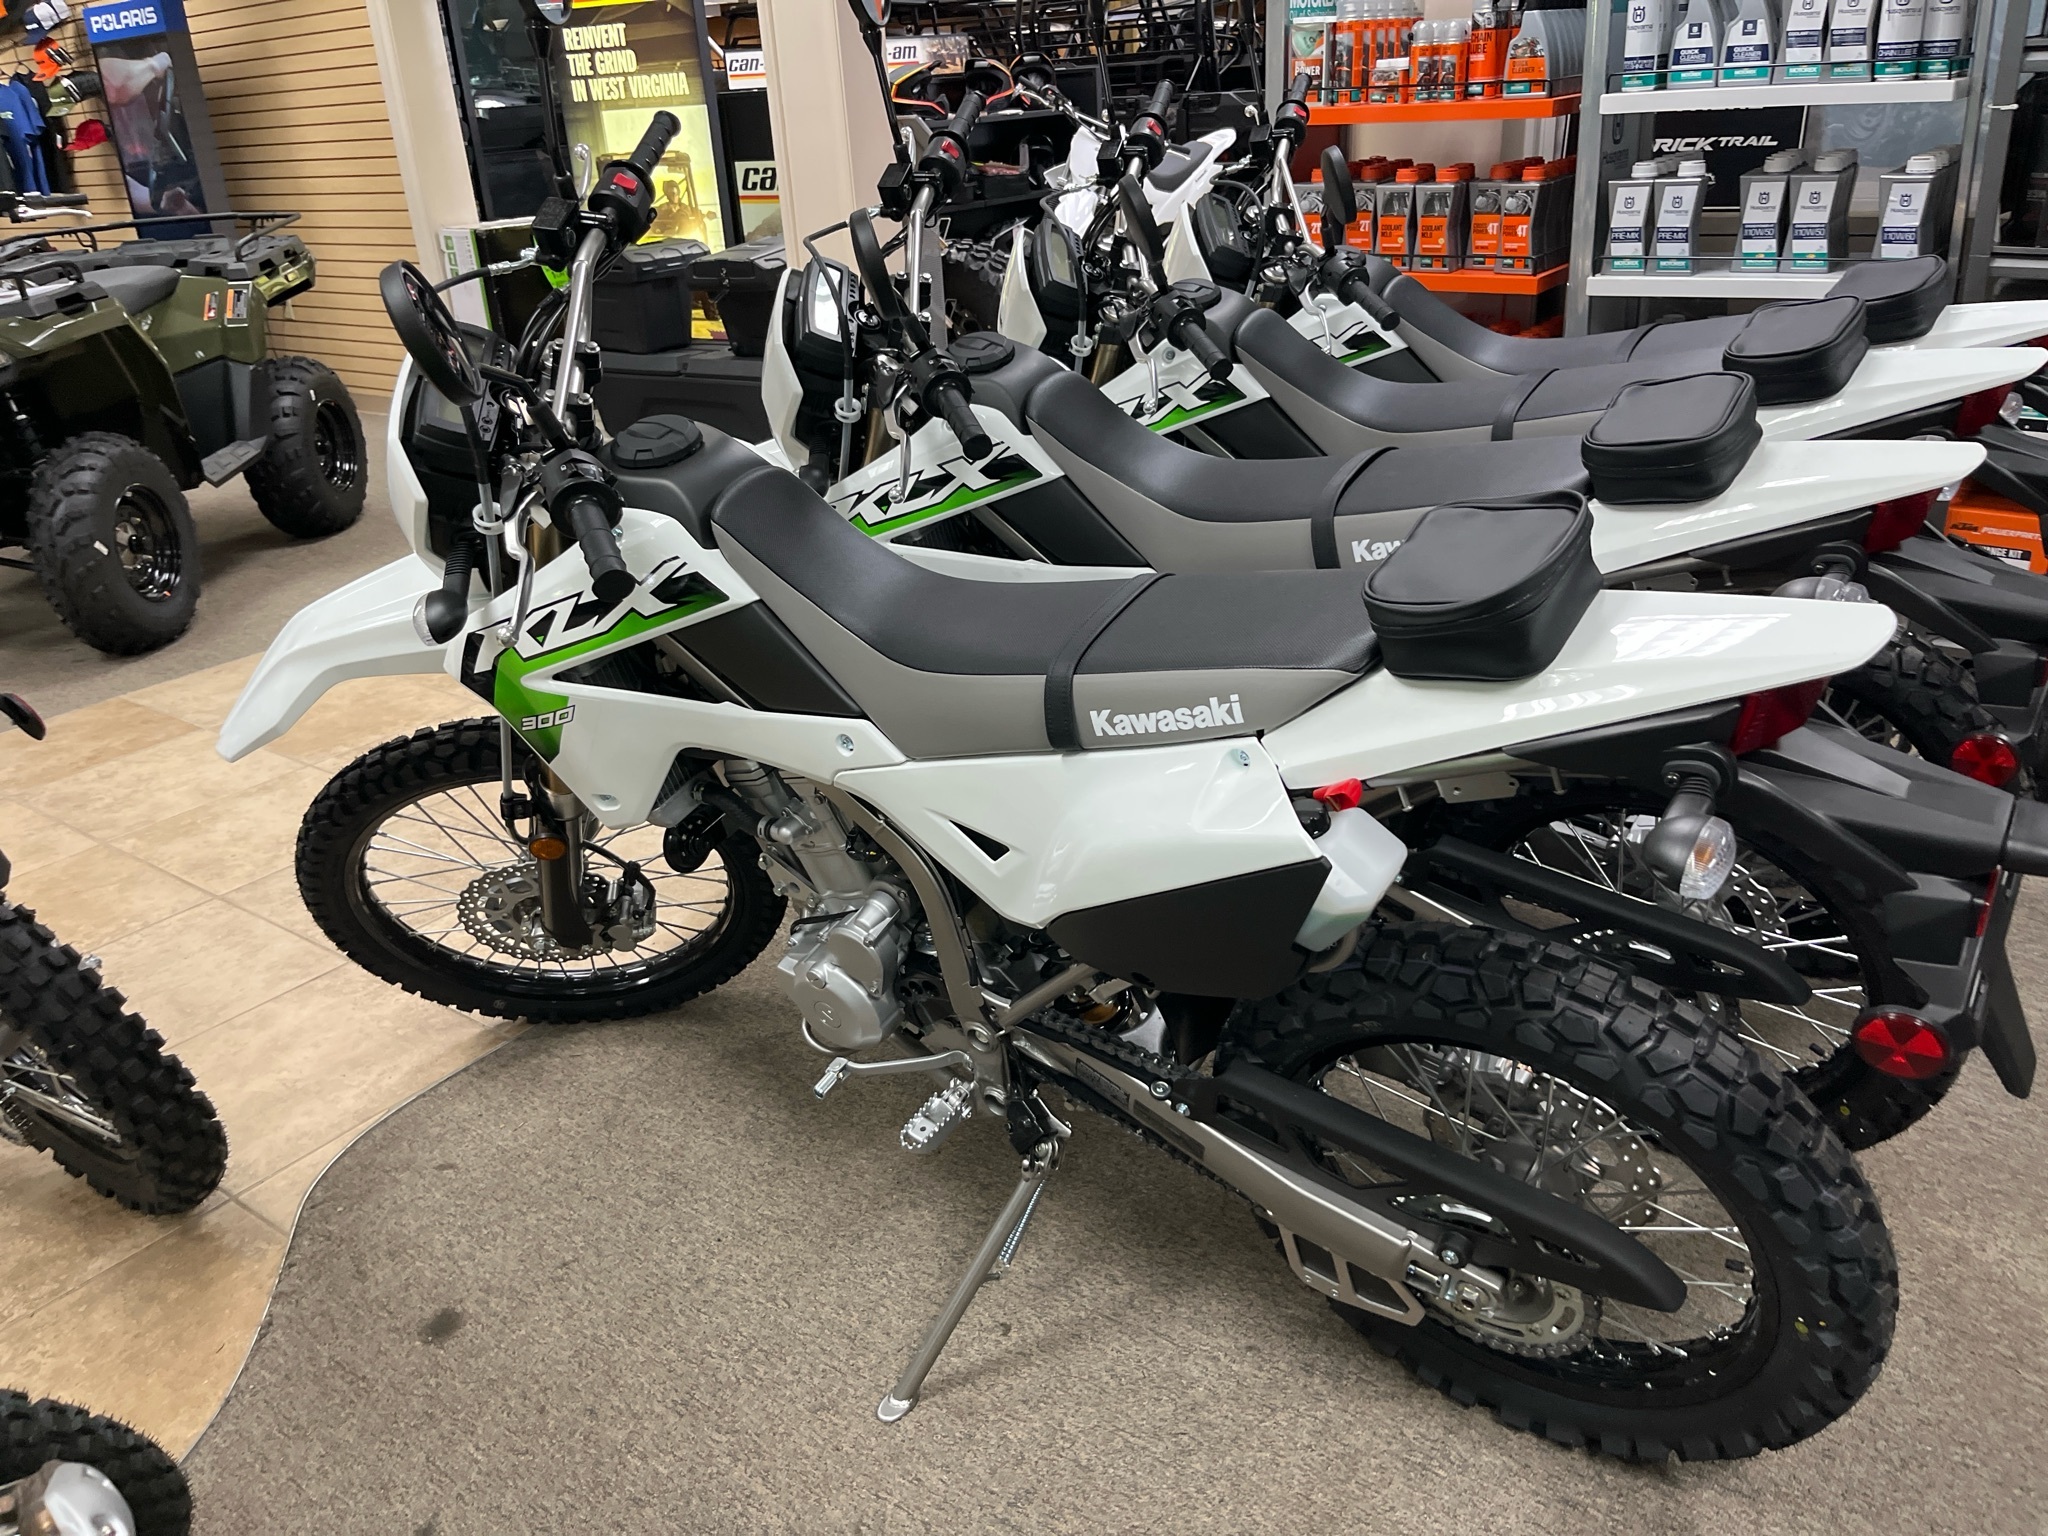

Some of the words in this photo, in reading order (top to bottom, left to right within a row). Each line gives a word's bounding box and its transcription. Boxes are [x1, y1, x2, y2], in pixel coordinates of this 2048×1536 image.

[90, 7, 158, 34] POLARIS
[562, 22, 627, 51] REINVENT
[1471, 32, 1493, 42] CHAIN
[1470, 43, 1487, 54] LUBE
[1733, 51, 1762, 59] CLEANER
[566, 52, 595, 77] THE
[594, 49, 638, 75] GRIND
[729, 57, 765, 72] can-
[1294, 65, 1321, 76] POWER
[570, 79, 589, 102] IN
[588, 76, 626, 101] WEST
[627, 71, 690, 99] VIRGINIA
[1653, 137, 1717, 152] RICK
[1717, 135, 1779, 147] TRAIL
[741, 167, 778, 191] ca
[1487, 223, 1499, 235] 4T
[1516, 225, 1528, 237] 4T
[1611, 232, 1640, 240] PRE-MIX
[1658, 232, 1687, 240] PRE-MIX
[2008, 550, 2024, 559] KIT
[473, 556, 688, 675] KLX
[521, 705, 576, 731] 300
[1089, 694, 1245, 737] Kawasaki
